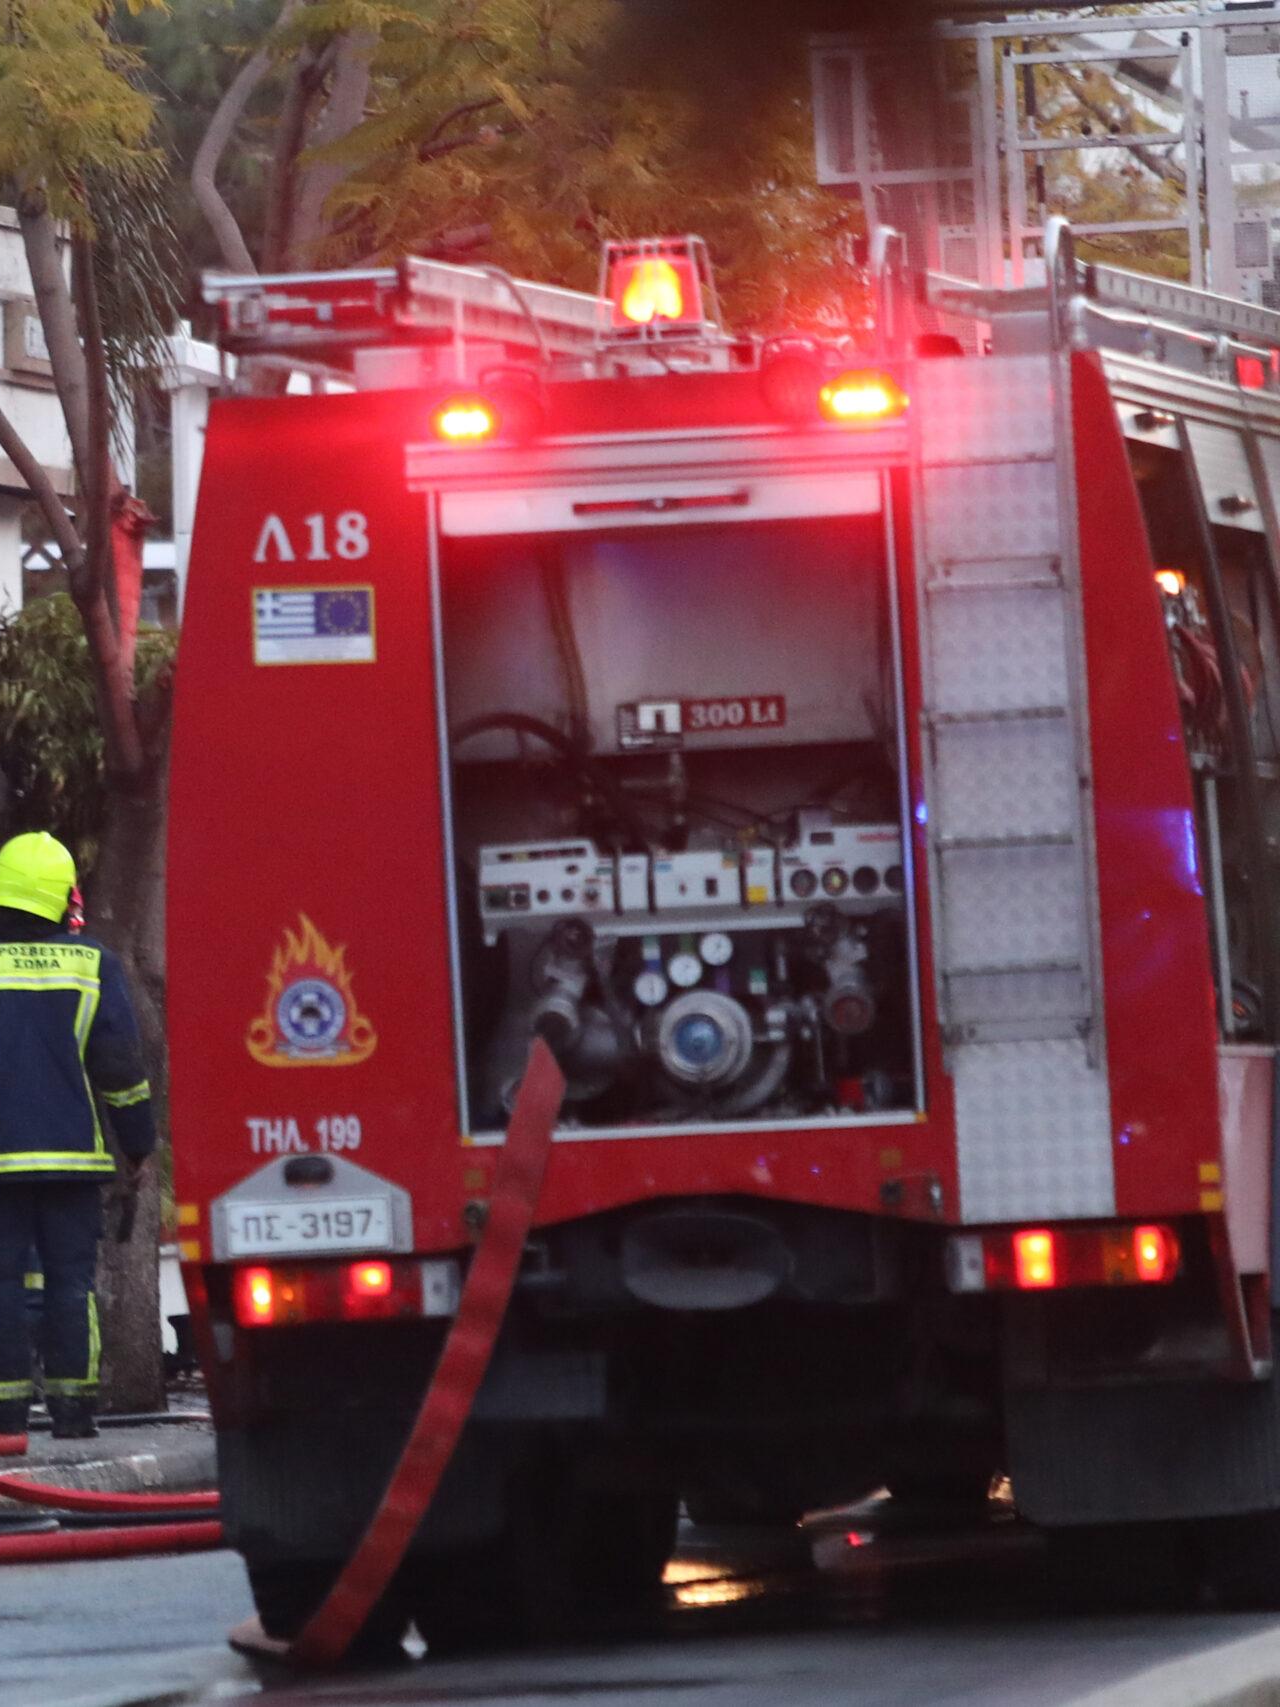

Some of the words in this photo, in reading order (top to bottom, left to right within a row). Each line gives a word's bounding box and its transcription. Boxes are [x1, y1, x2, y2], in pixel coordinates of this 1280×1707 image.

[688, 702, 745, 729] 300
[13, 958, 61, 969] ΣΩΜΑ
[316, 1114, 362, 1150] 199
